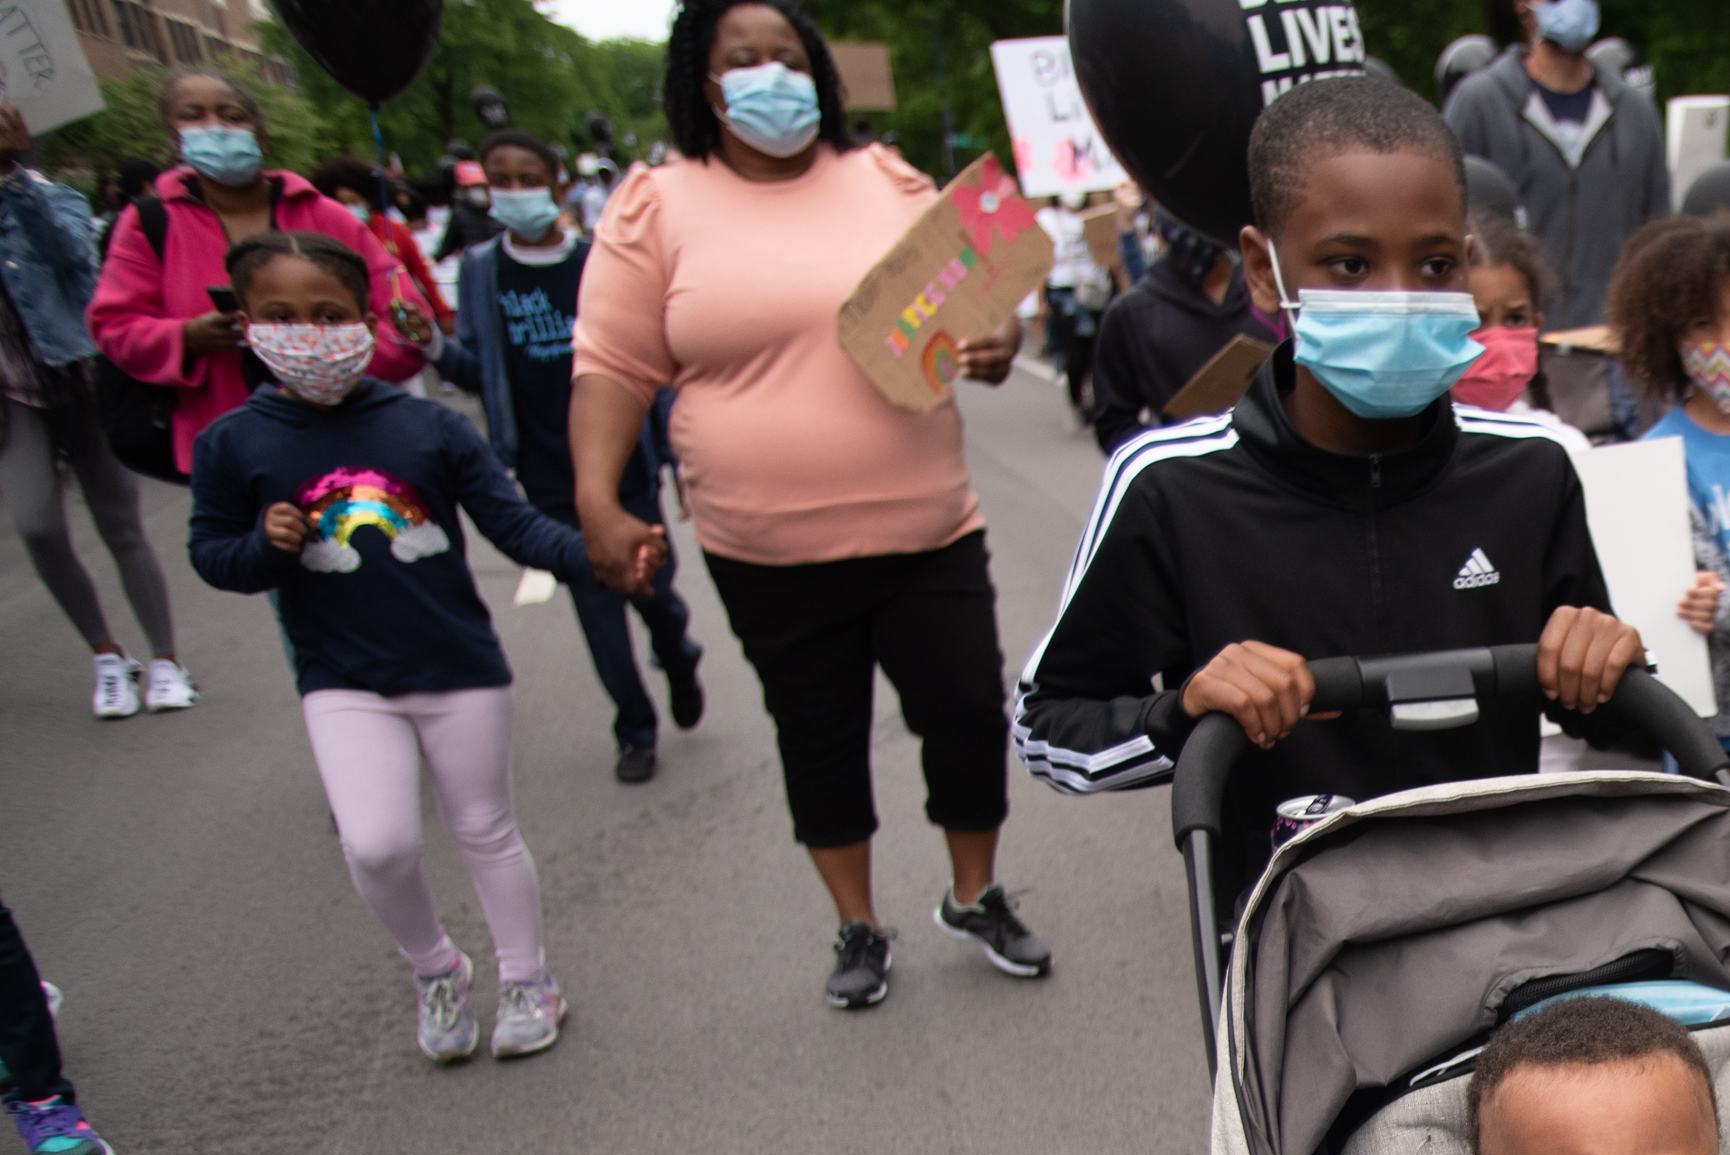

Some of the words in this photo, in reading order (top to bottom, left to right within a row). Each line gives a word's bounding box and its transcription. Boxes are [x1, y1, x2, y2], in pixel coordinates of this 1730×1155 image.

[0, 5, 57, 88] ATTER
[1246, 5, 1366, 73] LIVES
[1453, 571, 1500, 590] adidas
